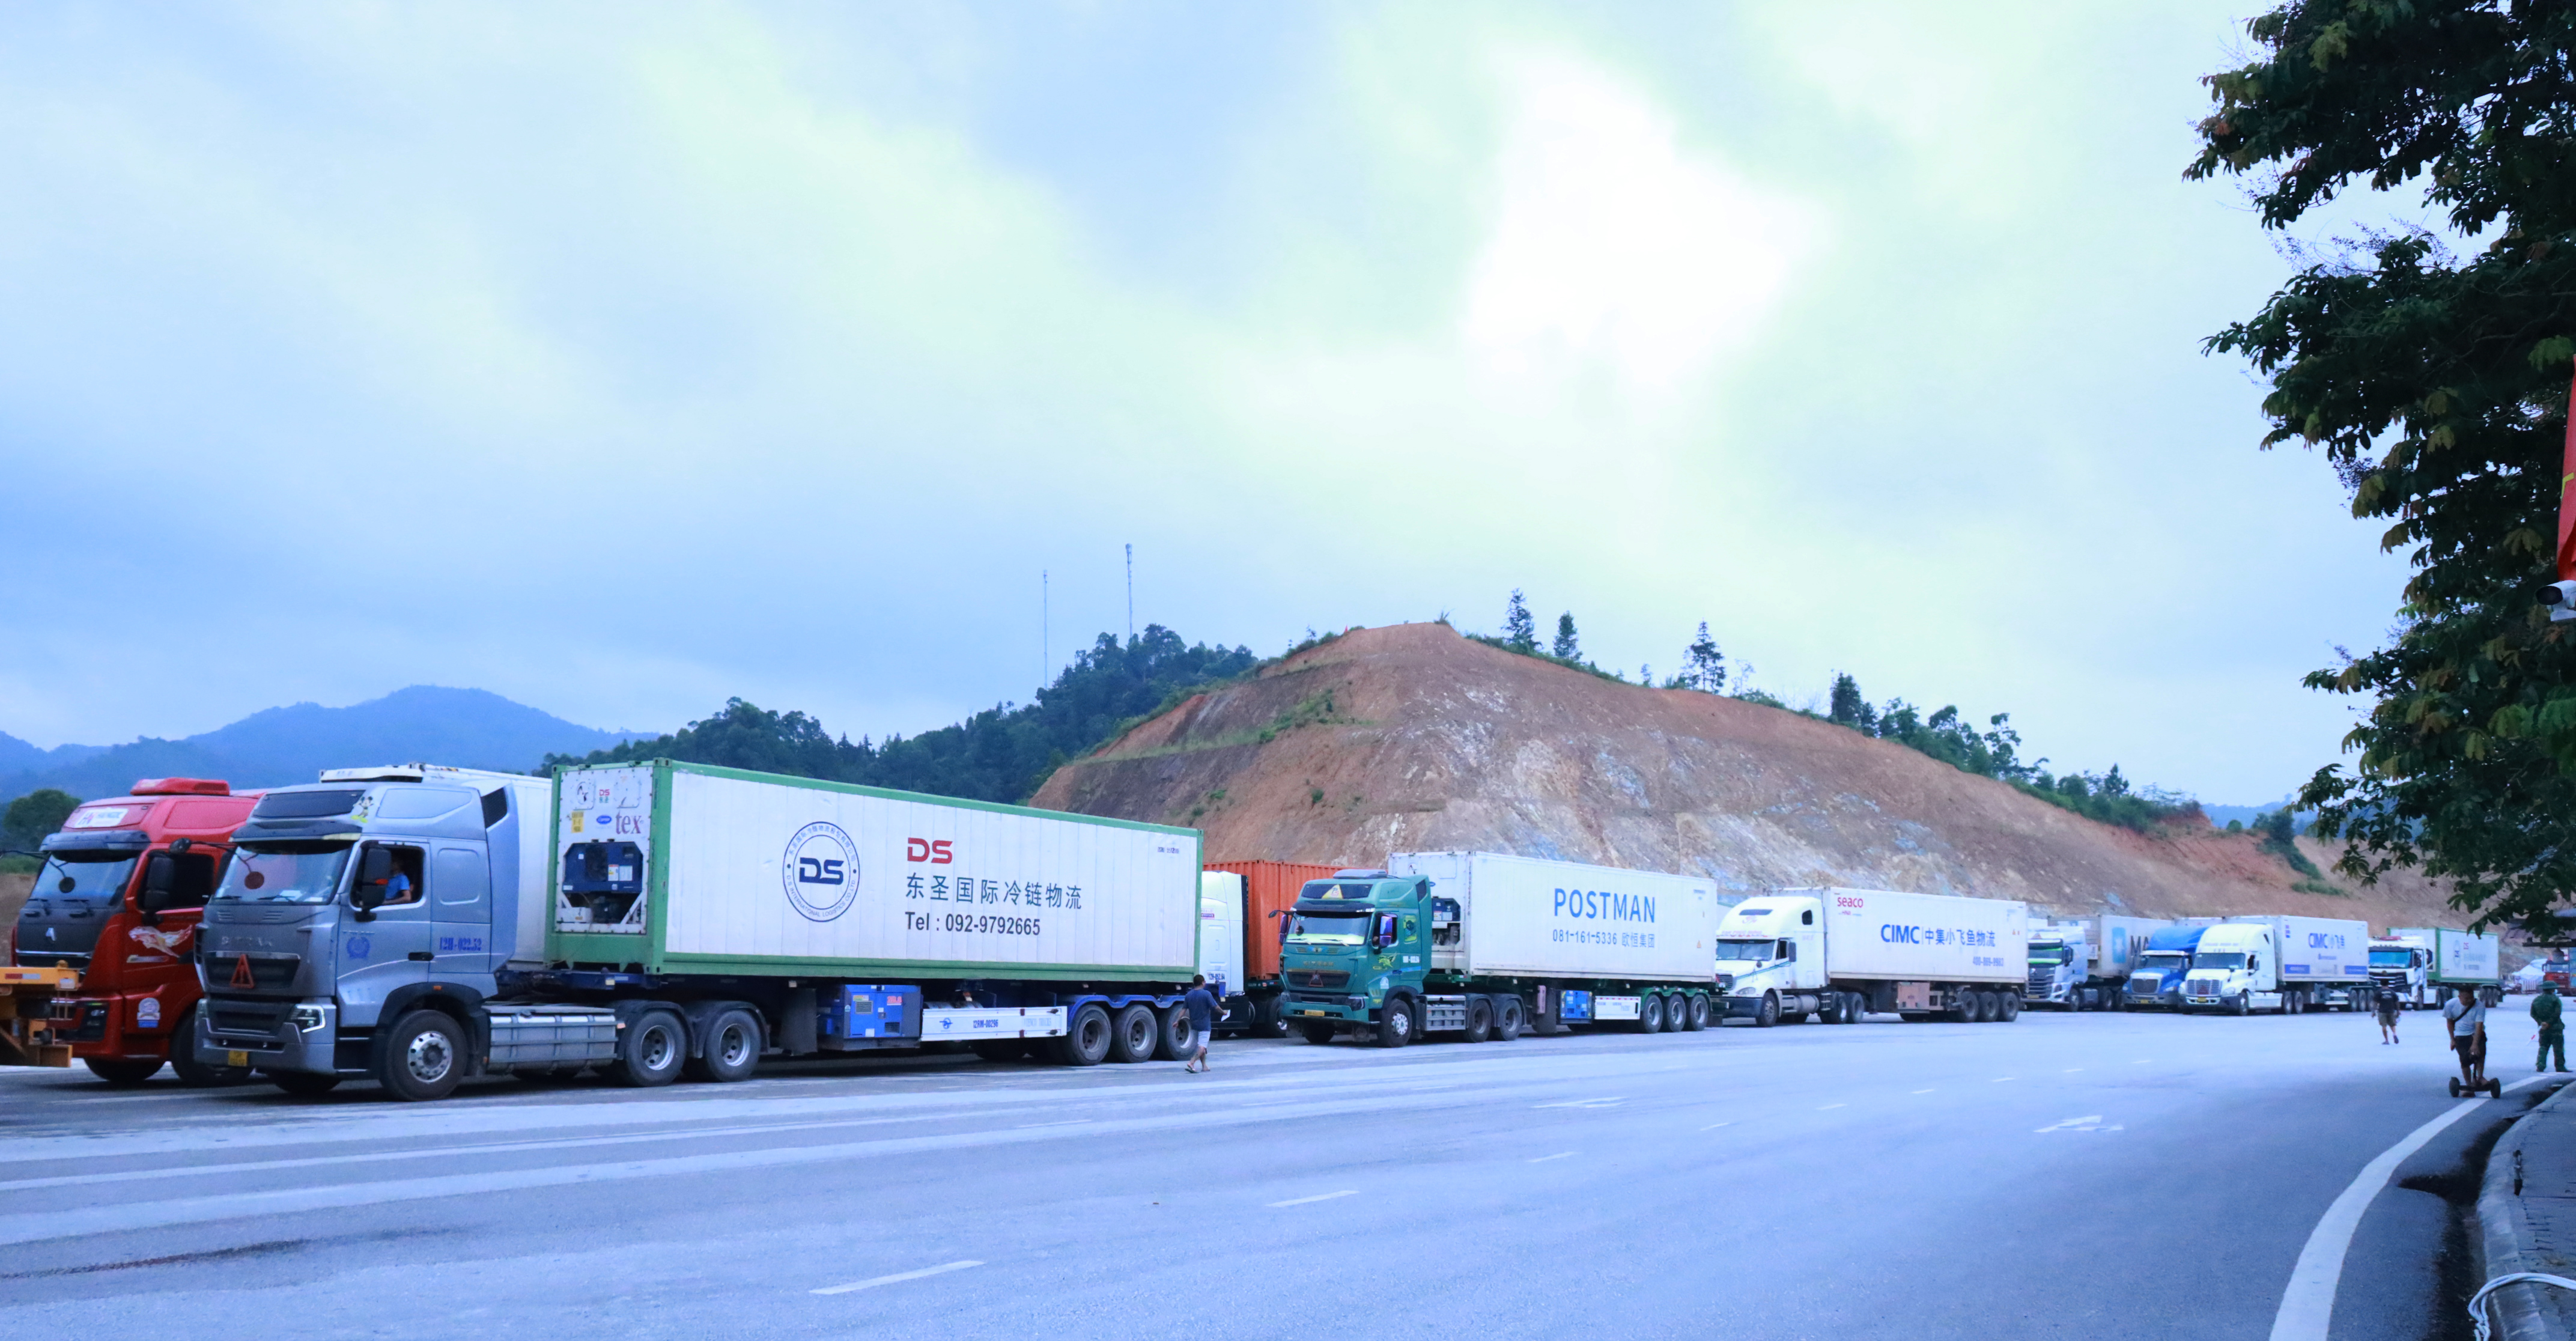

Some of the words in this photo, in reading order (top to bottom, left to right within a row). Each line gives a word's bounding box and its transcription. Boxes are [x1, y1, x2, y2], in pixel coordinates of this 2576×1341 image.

[615, 811, 642, 835] tex
[907, 837, 953, 864] DS
[799, 857, 844, 885] DS
[905, 872, 1082, 910] 东圣国际冷链物流
[1837, 896, 1864, 908] seaco
[1554, 888, 1655, 923] POSTMAN
[945, 913, 1040, 936] 092-9792665
[1881, 924, 1920, 944] CIMC
[1924, 927, 1996, 947] 中集小飞鱼物流
[1553, 929, 1617, 945] 081-161-5336
